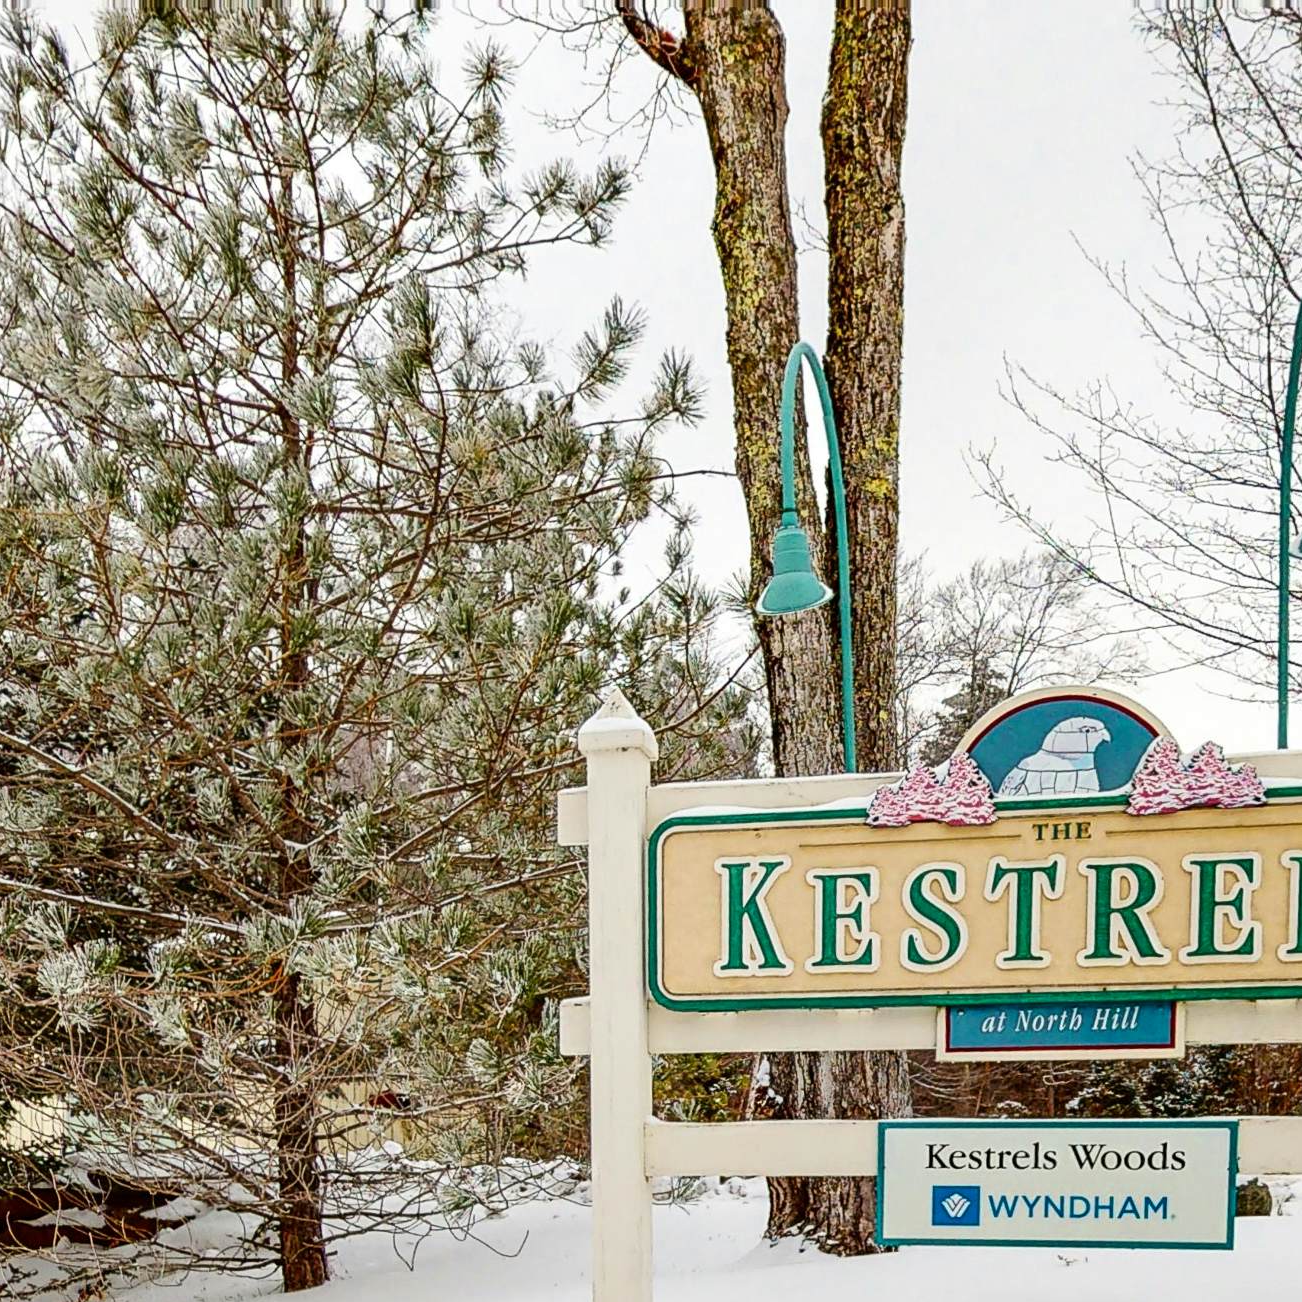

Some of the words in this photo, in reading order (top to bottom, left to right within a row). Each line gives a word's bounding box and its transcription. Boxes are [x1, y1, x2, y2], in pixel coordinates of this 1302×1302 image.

[1032, 820, 1093, 843] THE
[981, 1012, 1005, 1033] at
[1014, 1009, 1082, 1032] North
[1092, 1006, 1139, 1031] Hill
[925, 1141, 1058, 1171] Kestrels
[1068, 1141, 1187, 1171] Woods
[988, 1194, 1169, 1220] WYNDHAM
